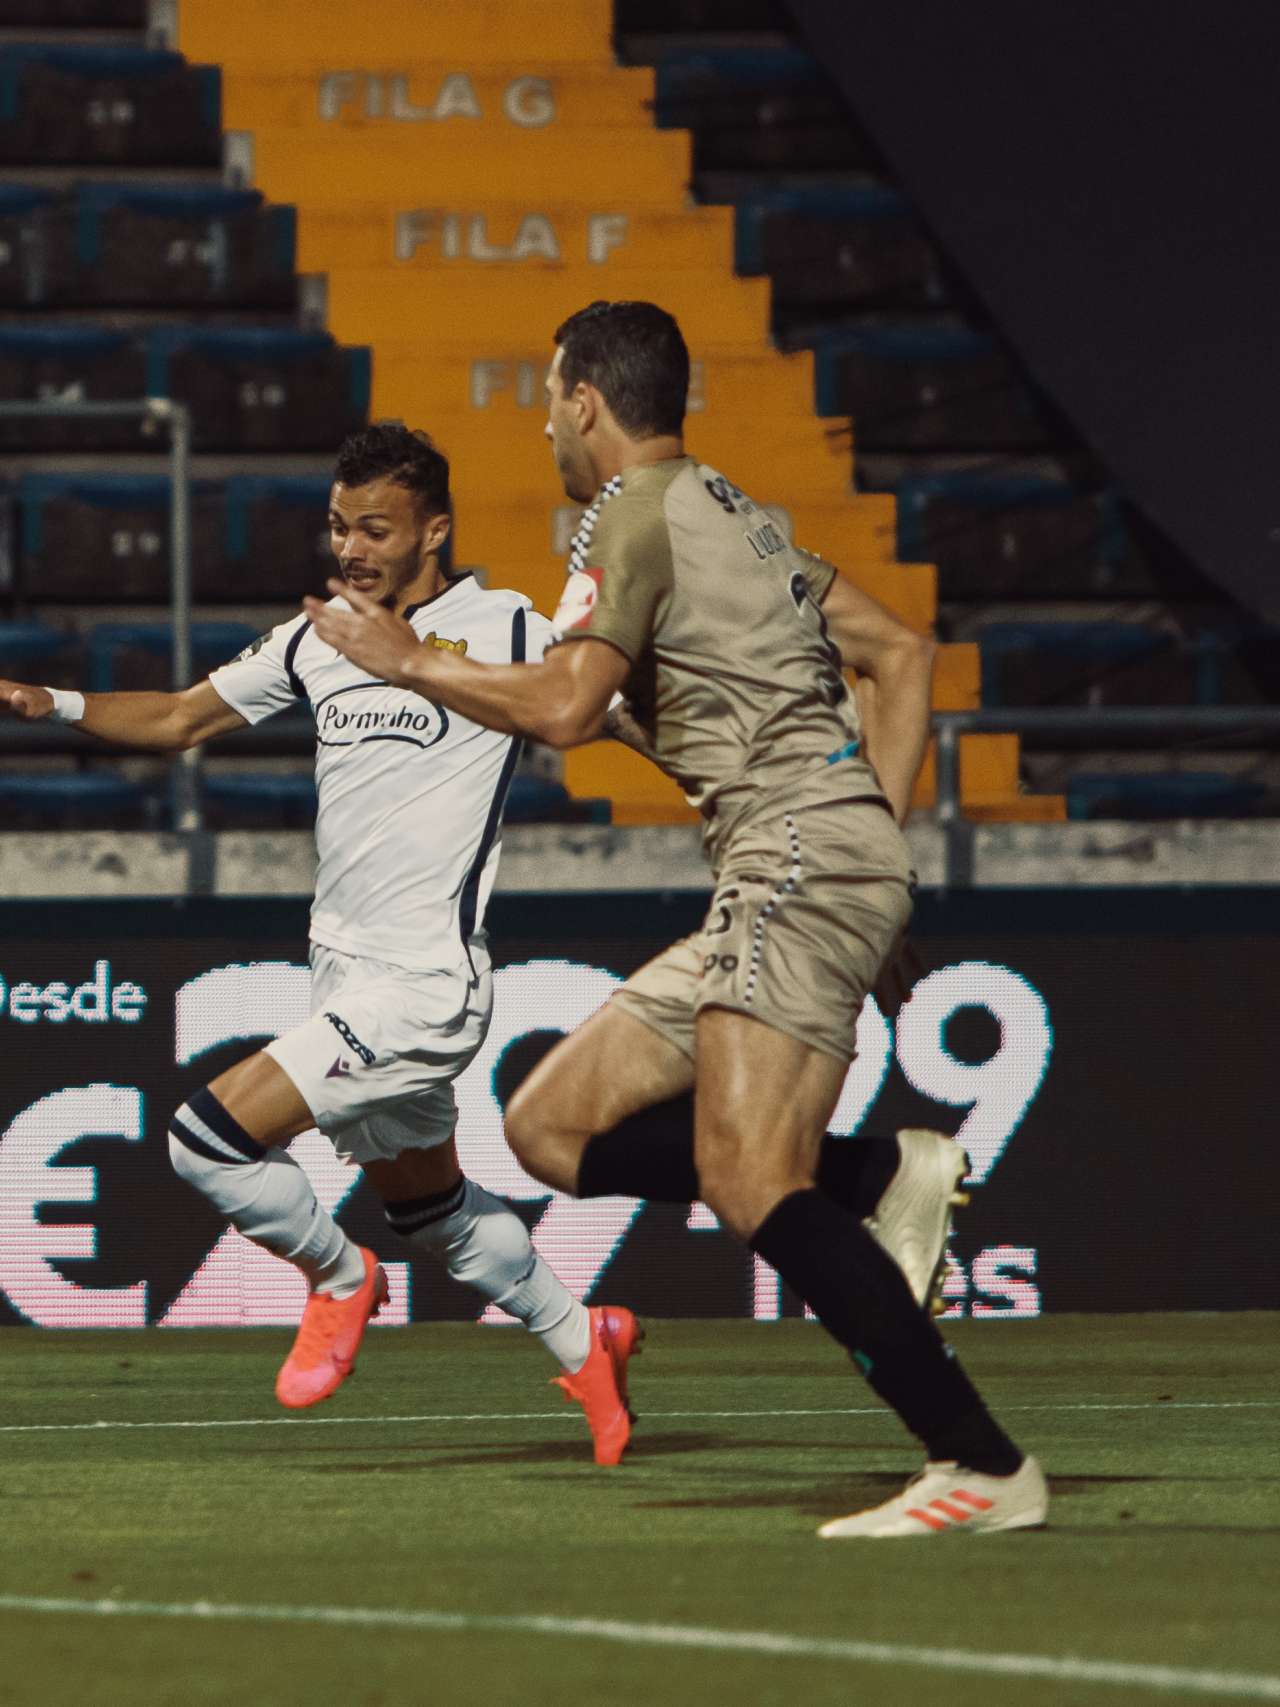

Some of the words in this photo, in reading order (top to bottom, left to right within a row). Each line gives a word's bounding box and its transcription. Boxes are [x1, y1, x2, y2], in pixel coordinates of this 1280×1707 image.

[320, 70, 481, 121] FILA
[504, 75, 556, 127] G
[395, 210, 560, 262] FILA
[587, 212, 627, 265] F
